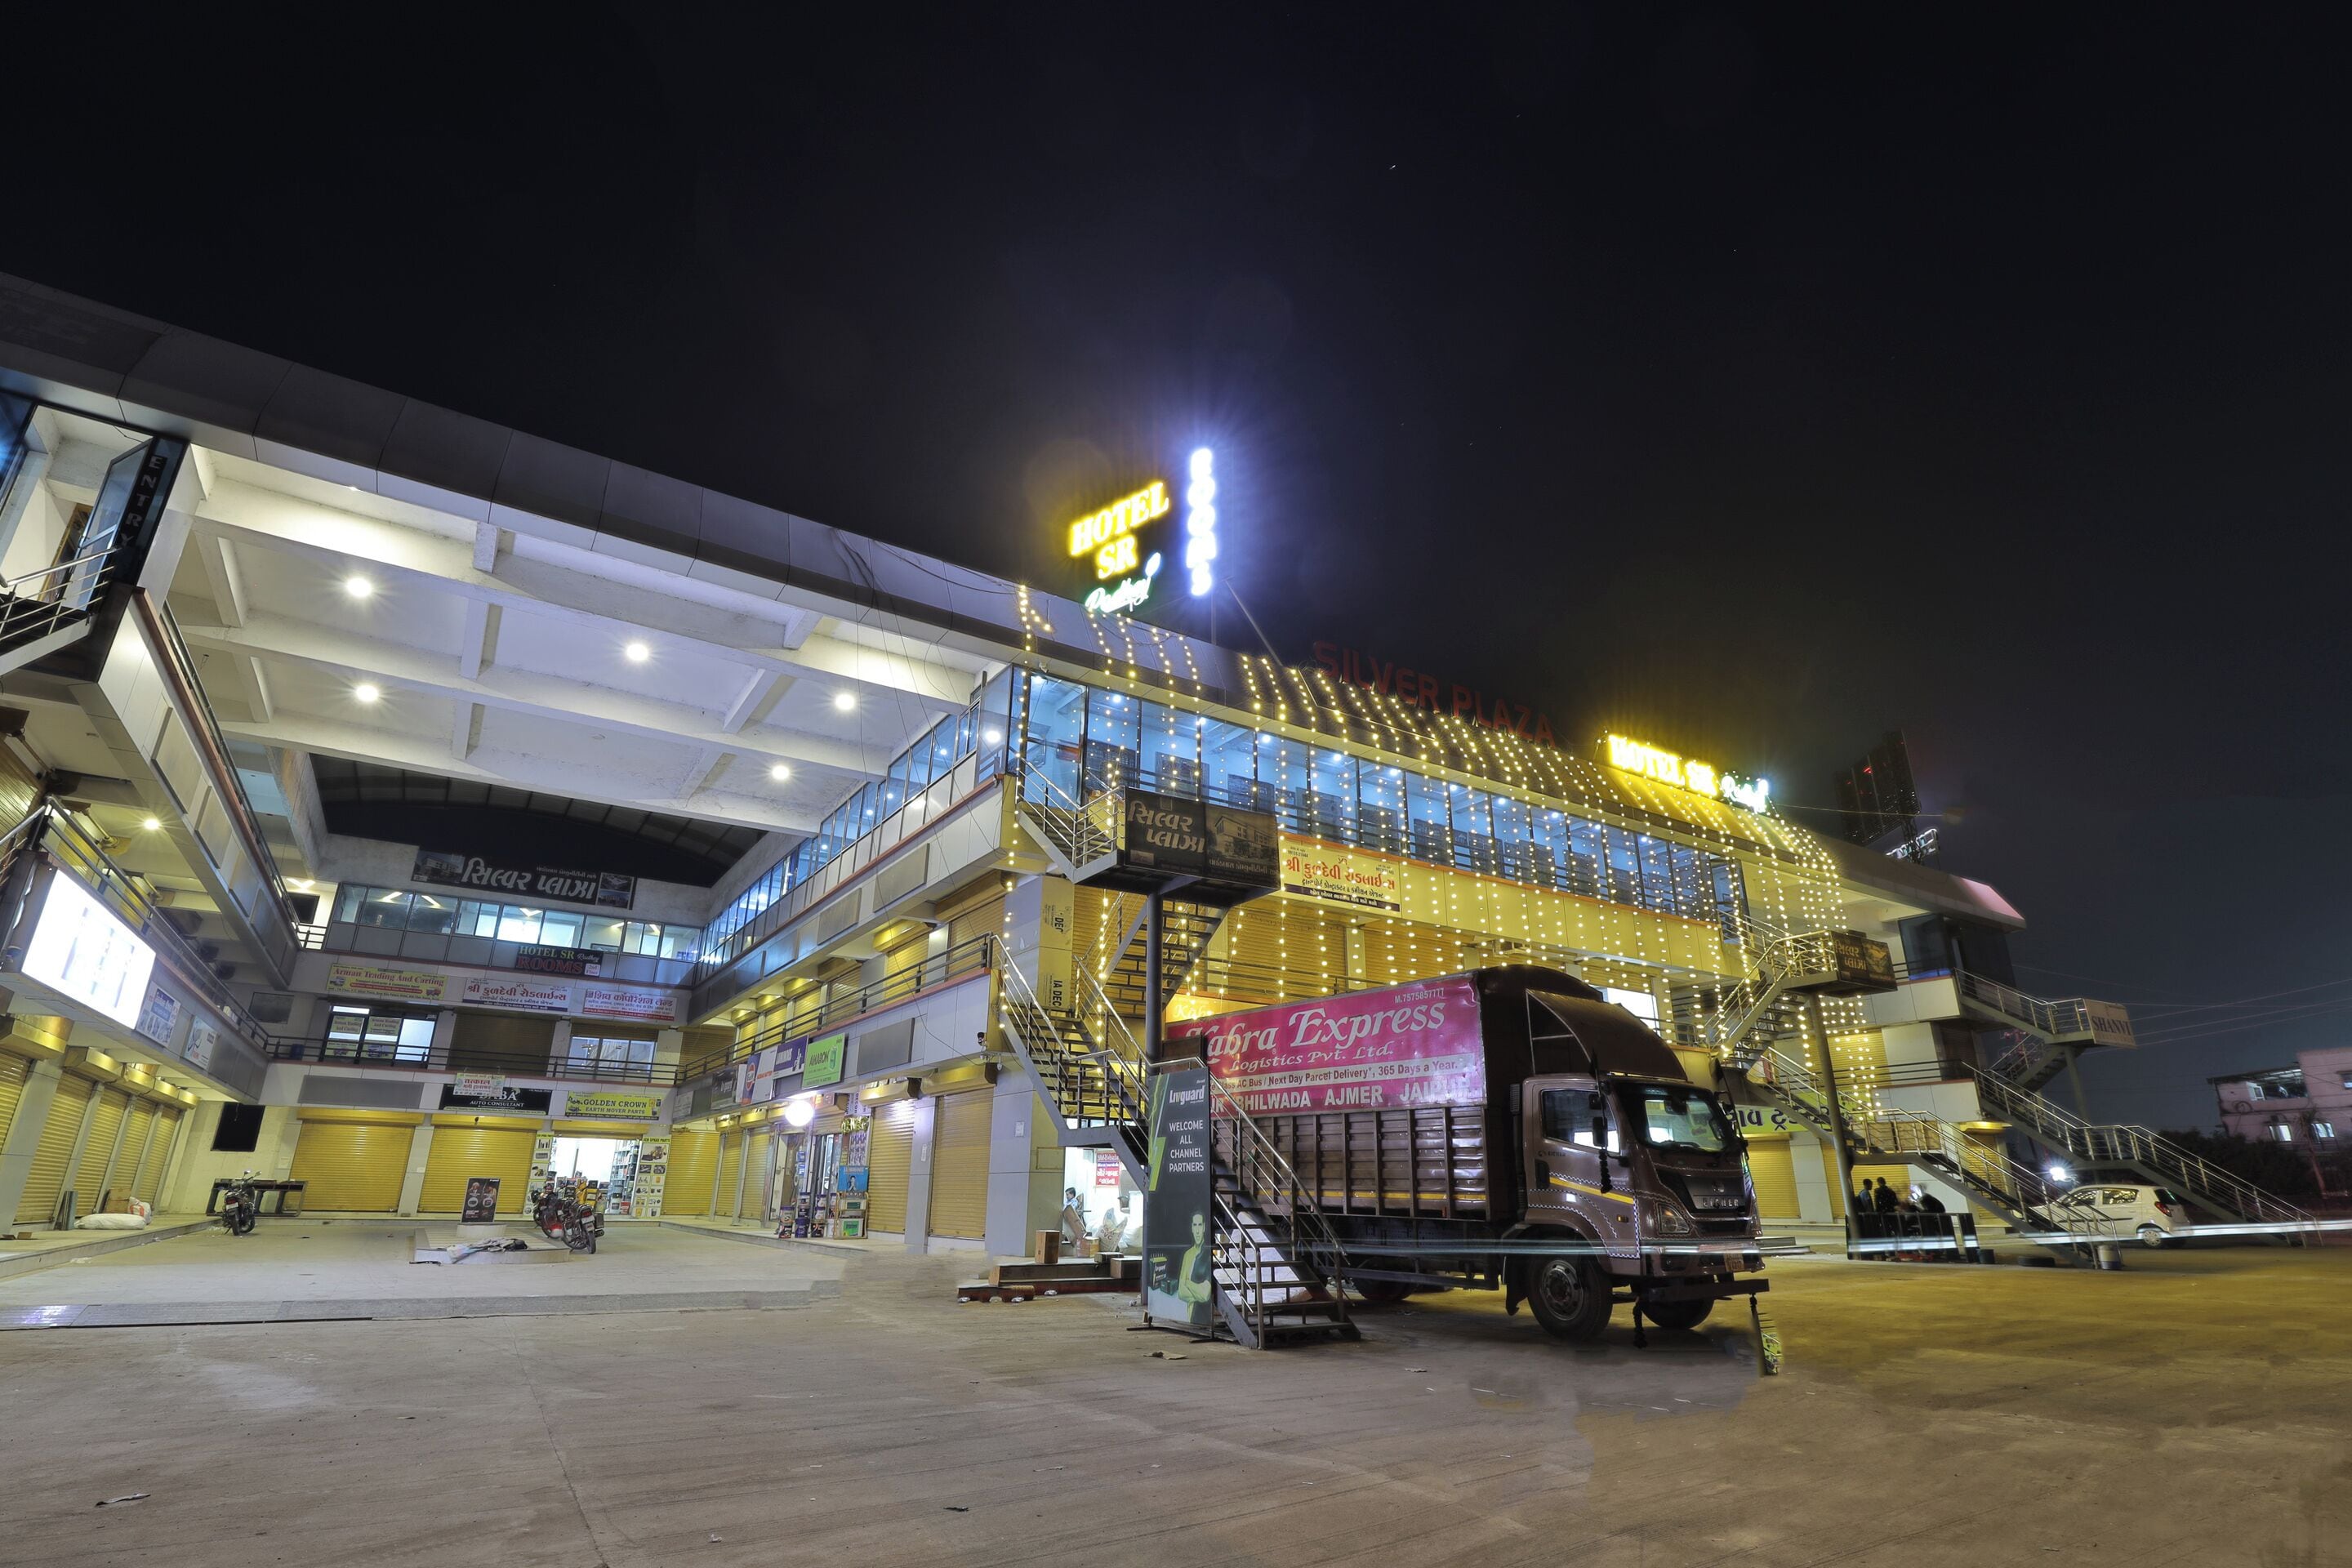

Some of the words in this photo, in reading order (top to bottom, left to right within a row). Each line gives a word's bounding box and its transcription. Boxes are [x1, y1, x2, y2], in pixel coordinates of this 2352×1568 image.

[120, 456, 163, 546] ENTRY
[1070, 482, 1169, 556] HOTEL
[1097, 535, 1137, 580] SR
[1313, 640, 1441, 715] SILVER
[1451, 684, 1556, 747] PLAZA
[1129, 800, 1193, 832] સિલ્વર
[461, 858, 531, 891] સિલ્વર
[519, 946, 558, 959] HOTEL
[560, 950, 575, 960] SR
[516, 956, 583, 974] ROOMS
[334, 968, 362, 978] Arman
[364, 971, 394, 982] Trading
[397, 974, 413, 982] And
[414, 977, 444, 987] Carting
[1289, 1002, 1446, 1049] Express
[2091, 1015, 2132, 1036] SHANVI
[1229, 1051, 1303, 1073] Logistics
[1307, 1049, 1346, 1062] Pvt.
[1352, 1040, 1396, 1060] Ltd.
[1237, 1079, 1248, 1088] AC
[1249, 1077, 1263, 1087] Bus
[1267, 1075, 1286, 1086] Next
[1288, 1074, 1303, 1085] Day
[1305, 1071, 1333, 1082] Parcel
[1378, 1064, 1395, 1076] 365
[1397, 1063, 1421, 1076] Days
[1432, 1060, 1458, 1071] Year.
[584, 1098, 617, 1107] GOLDEN
[1169, 1085, 1205, 1105] Livguard
[1236, 1091, 1312, 1111] BHILWADA
[1324, 1085, 1384, 1106] AJMER
[1169, 1120, 1204, 1132] WELCOME
[1179, 1135, 1192, 1144] ALL
[1170, 1148, 1203, 1159] CHANNEL
[1169, 1161, 1205, 1173] PARTNERS
